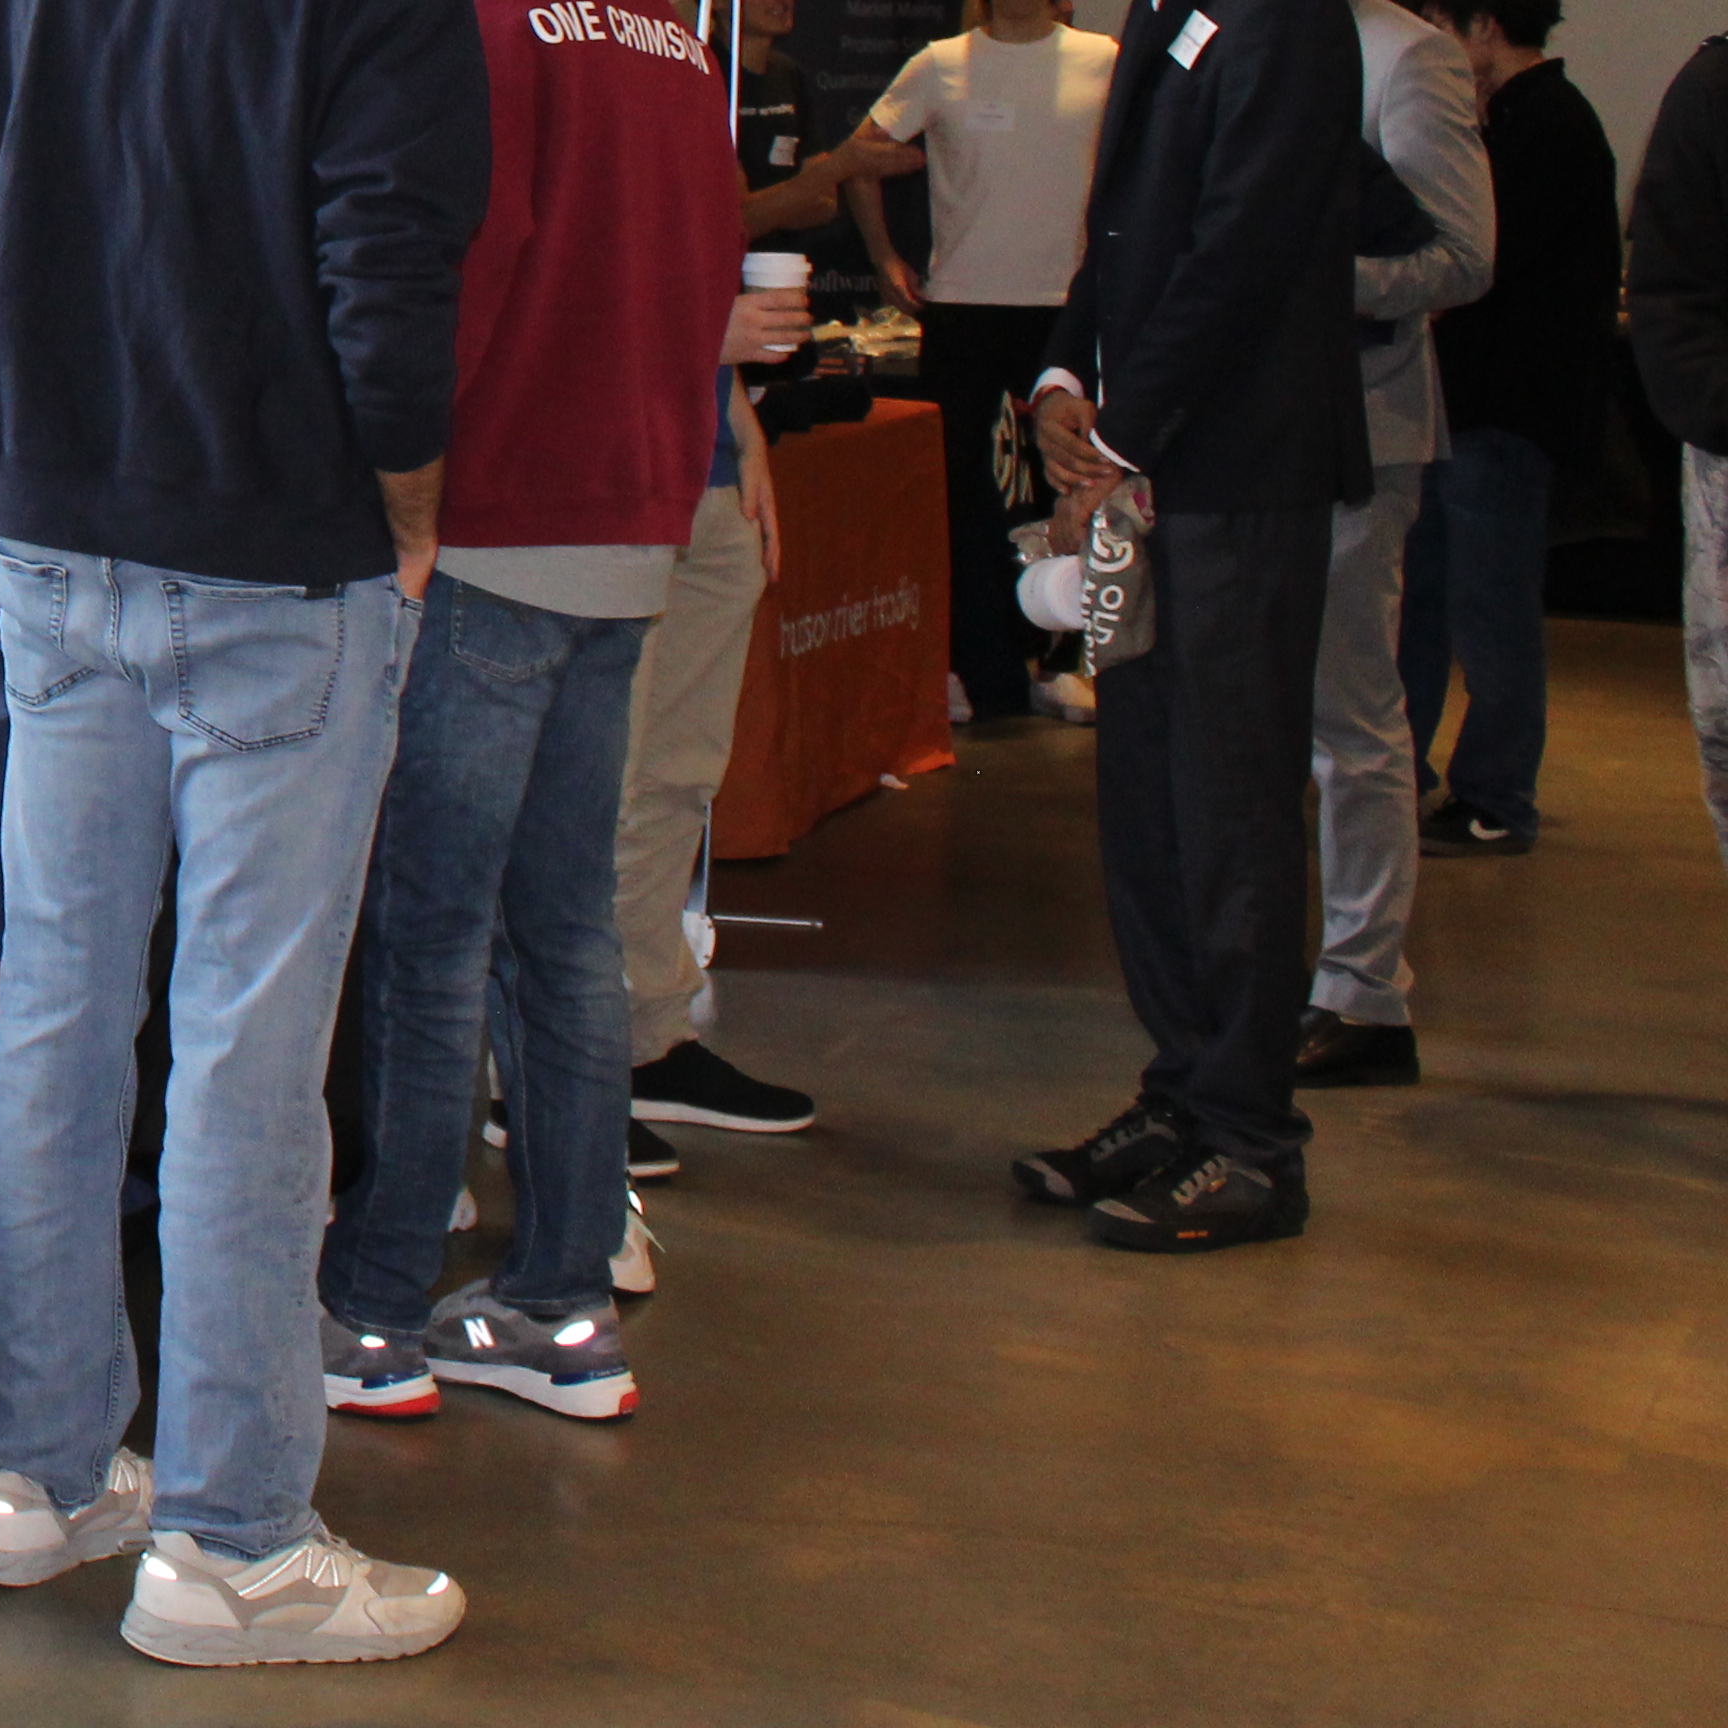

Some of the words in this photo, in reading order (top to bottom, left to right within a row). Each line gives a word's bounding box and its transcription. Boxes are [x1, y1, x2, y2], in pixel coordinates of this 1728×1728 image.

[528, 0, 608, 44] ONE
[1092, 584, 1125, 646] OLD
[463, 1316, 495, 1350] N
